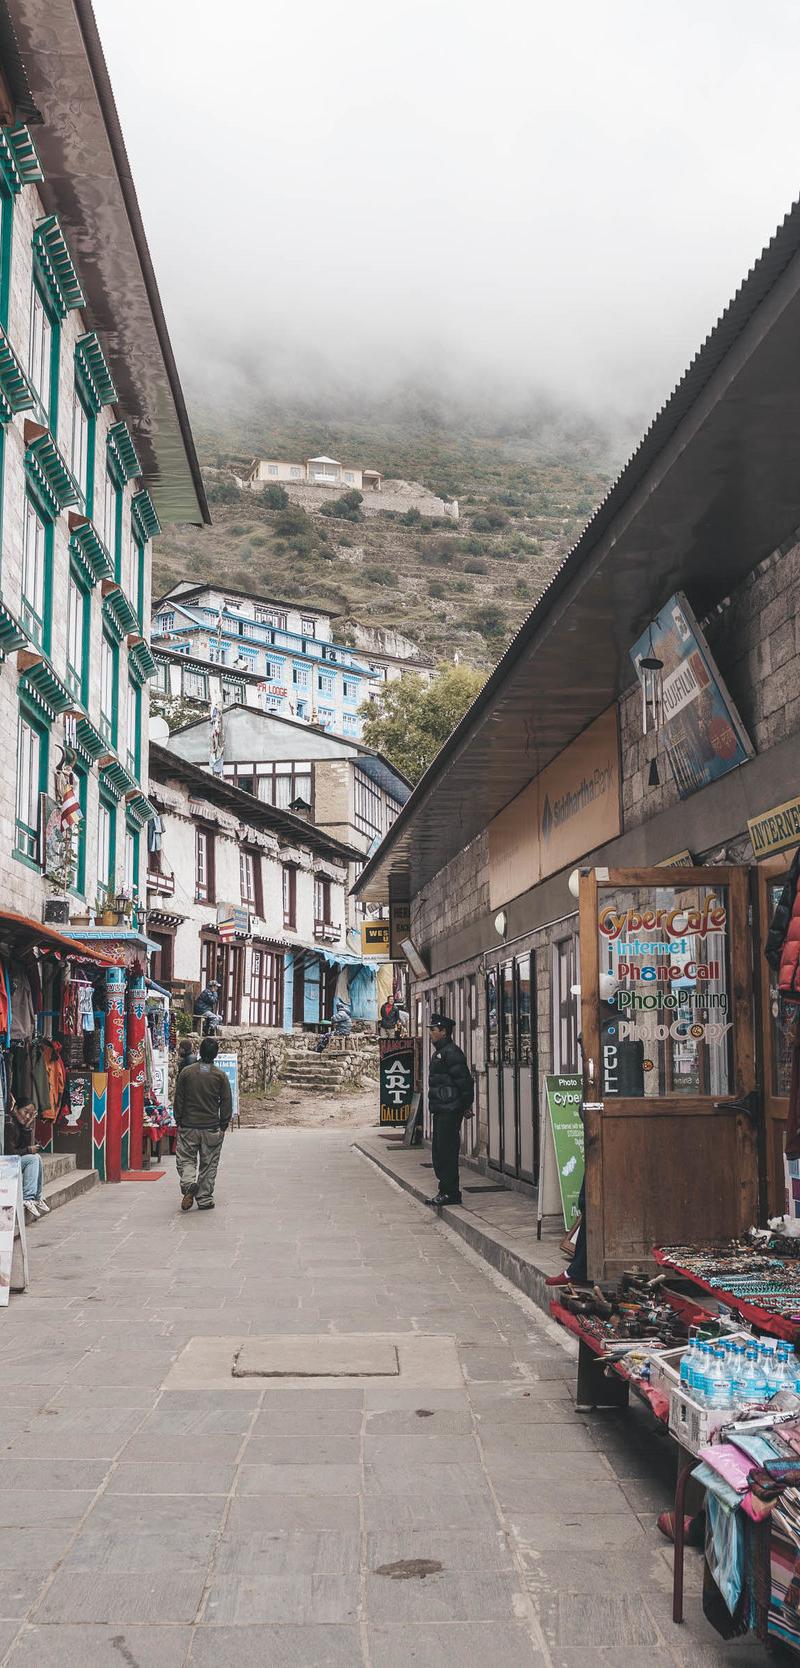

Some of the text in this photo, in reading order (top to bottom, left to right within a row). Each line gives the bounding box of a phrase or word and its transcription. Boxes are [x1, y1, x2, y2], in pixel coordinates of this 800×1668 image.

[268, 684, 288, 698] LODGE
[663, 667, 697, 713] FUJIFILM
[751, 803, 800, 851] INTERNE
[617, 939, 688, 956] Internet
[384, 1060, 411, 1104] ART
[558, 1078, 578, 1086] Photo
[603, 1045, 619, 1093] PULL
[381, 1103, 413, 1122] GALLER
